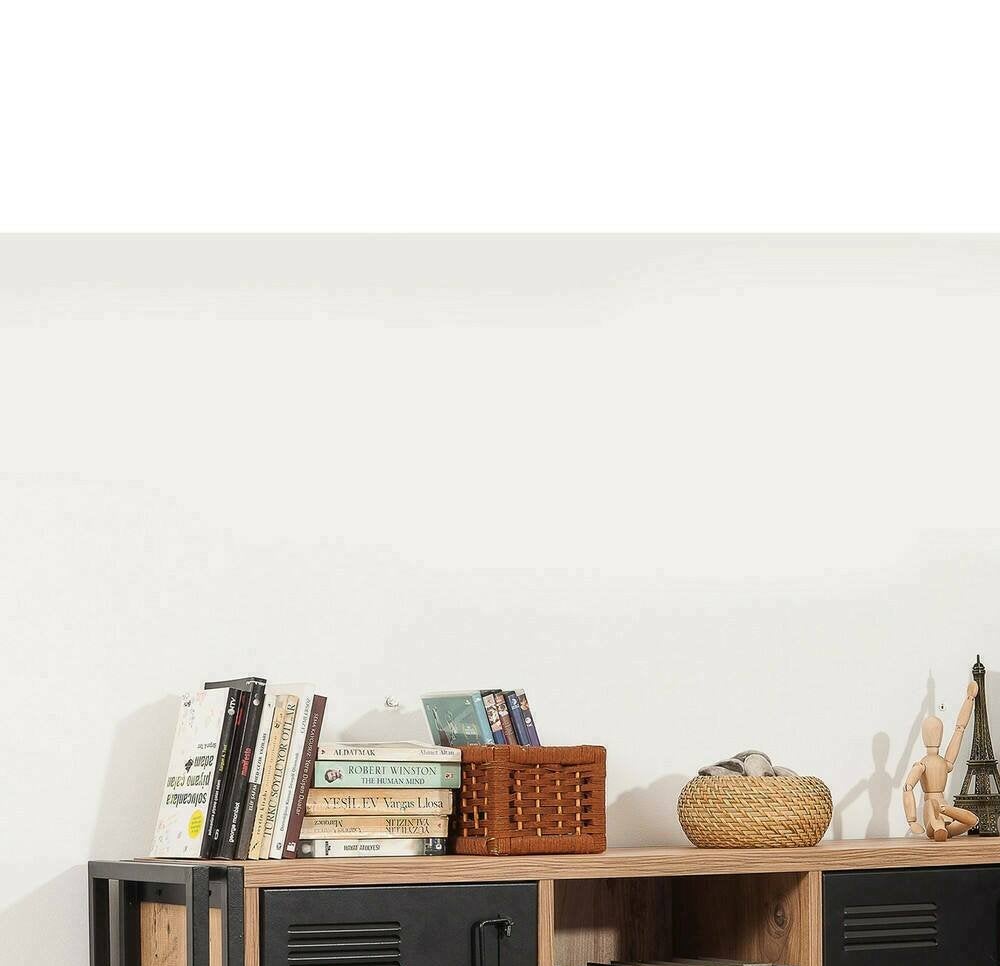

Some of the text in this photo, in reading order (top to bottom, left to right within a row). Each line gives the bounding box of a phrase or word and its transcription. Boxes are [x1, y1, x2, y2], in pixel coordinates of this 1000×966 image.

[281, 704, 296, 741] OTLAR
[305, 728, 316, 756] KAYGUSUZ
[194, 755, 214, 769] adam
[241, 747, 252, 776] manifesto
[302, 759, 312, 773] Yere
[348, 765, 437, 776] ROBERT WINSTON
[186, 772, 212, 789] piyano
[166, 792, 208, 808] solucanlara
[296, 794, 304, 816] Dualar
[363, 796, 380, 808] EV
[384, 797, 416, 814] Vargas
[418, 796, 444, 808] Llosa
[228, 802, 240, 843] george monbiot
[385, 818, 430, 827] YALNIZLIK
